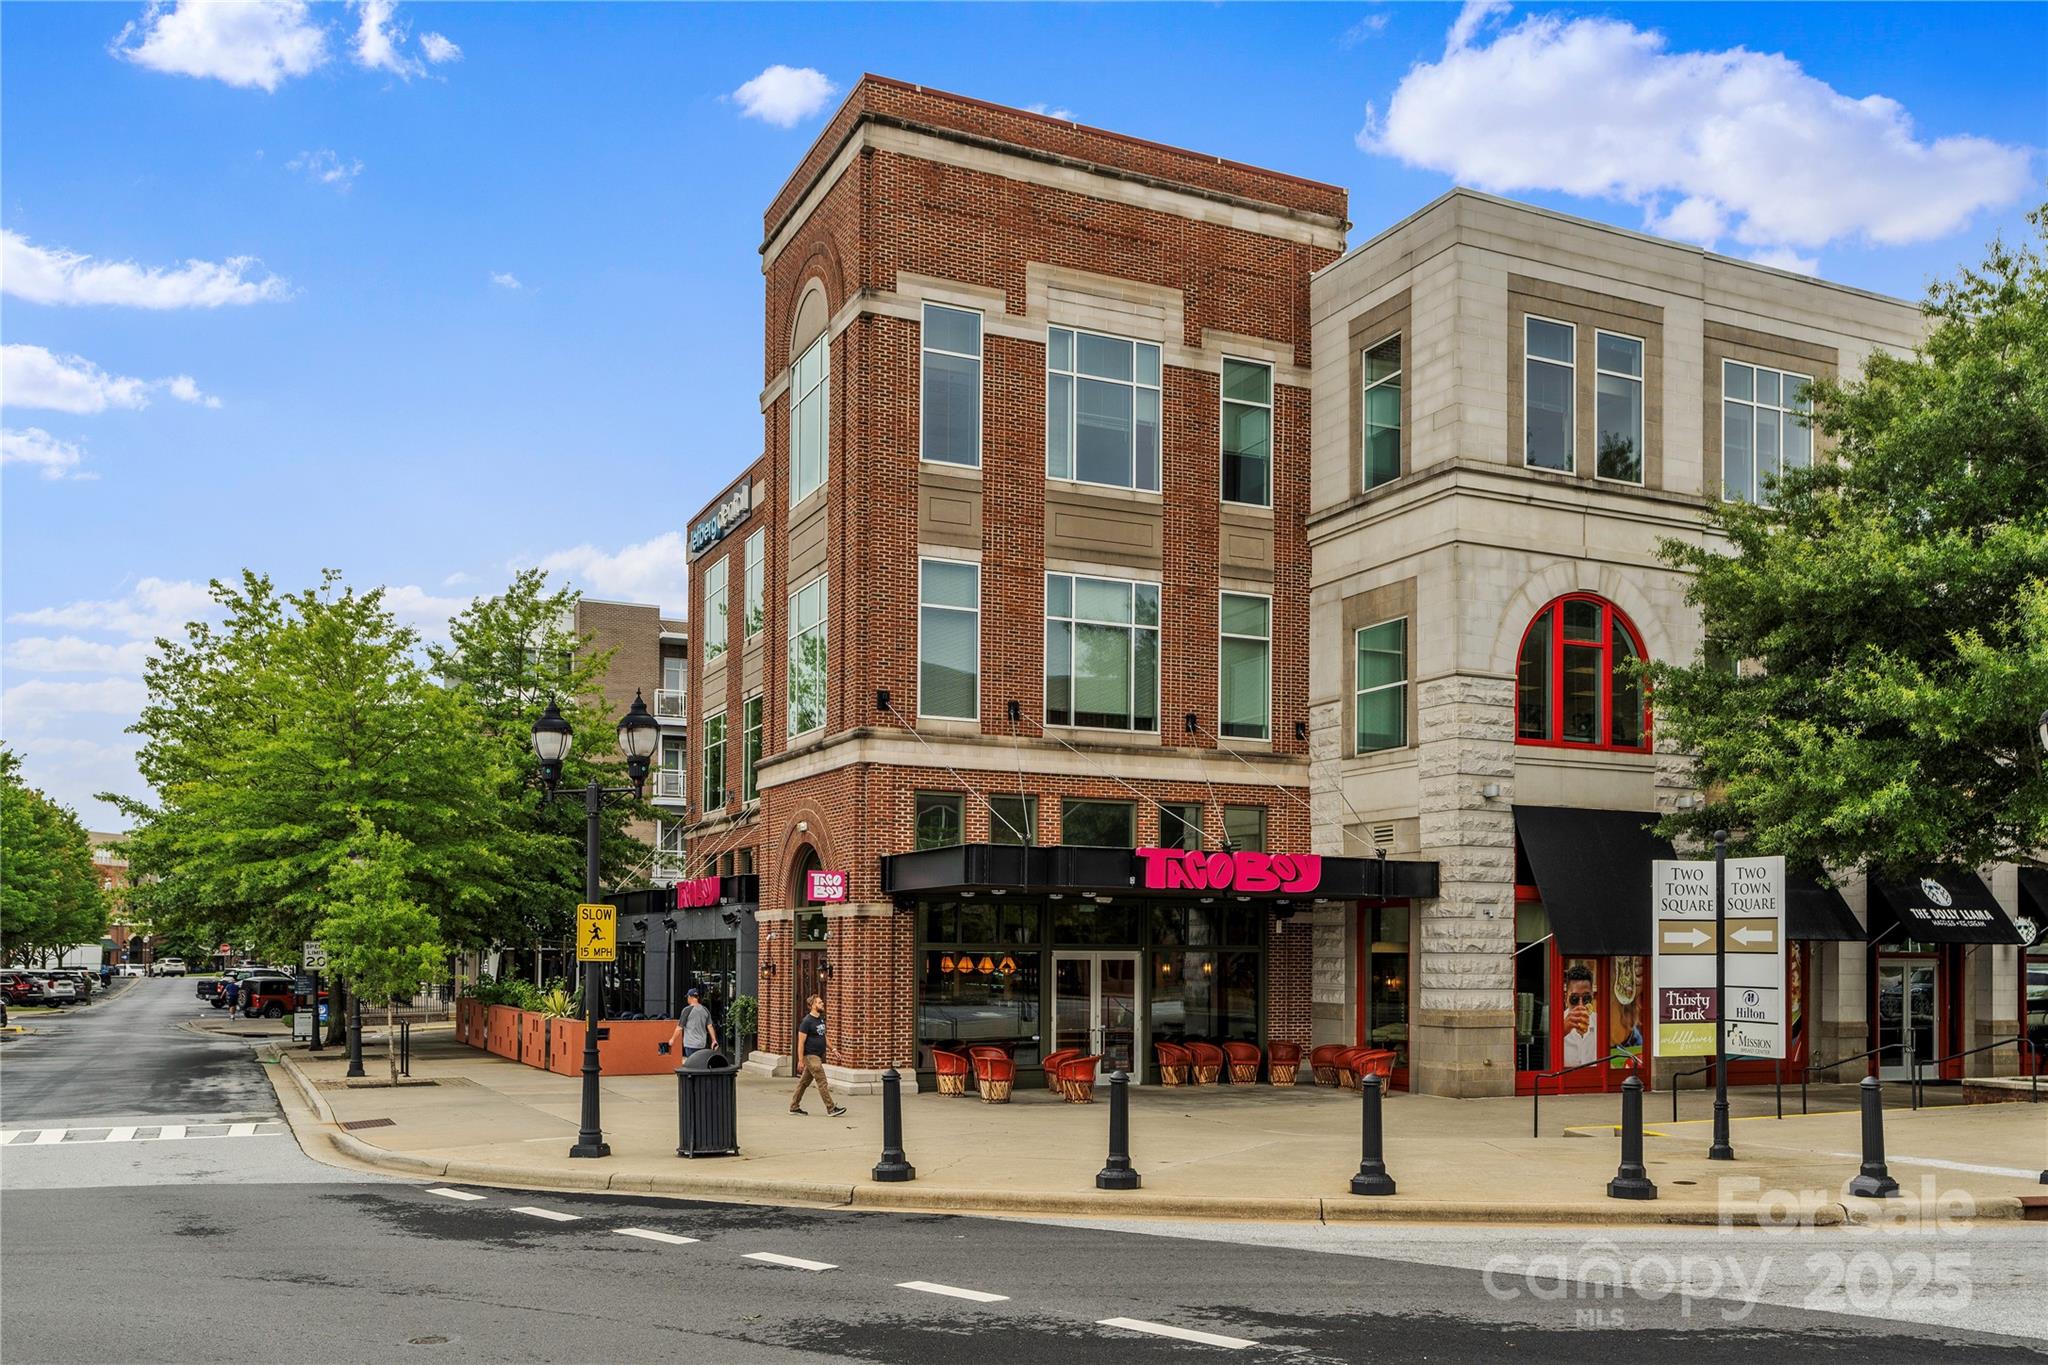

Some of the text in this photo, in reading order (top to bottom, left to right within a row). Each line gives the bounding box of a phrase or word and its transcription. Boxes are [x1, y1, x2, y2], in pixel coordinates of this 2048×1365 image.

[811, 873, 842, 886] TACO
[1671, 867, 1704, 881] TWO
[1736, 866, 1766, 880] TWO
[813, 886, 844, 899] BOY
[1665, 882, 1709, 896] TOWN
[1731, 882, 1771, 896] TOWN
[1661, 898, 1714, 914] SQUARE
[1727, 897, 1776, 913] SQUARE
[582, 908, 612, 920] SLOW
[1909, 908, 1995, 920] THE DOLLY LLAMA
[580, 947, 612, 957] 15 MPH
[306, 956, 325, 967] 20
[1665, 990, 1710, 1007] Thirsty
[1671, 1008, 1706, 1020] Monk
[1736, 1007, 1766, 1019] Hilton
